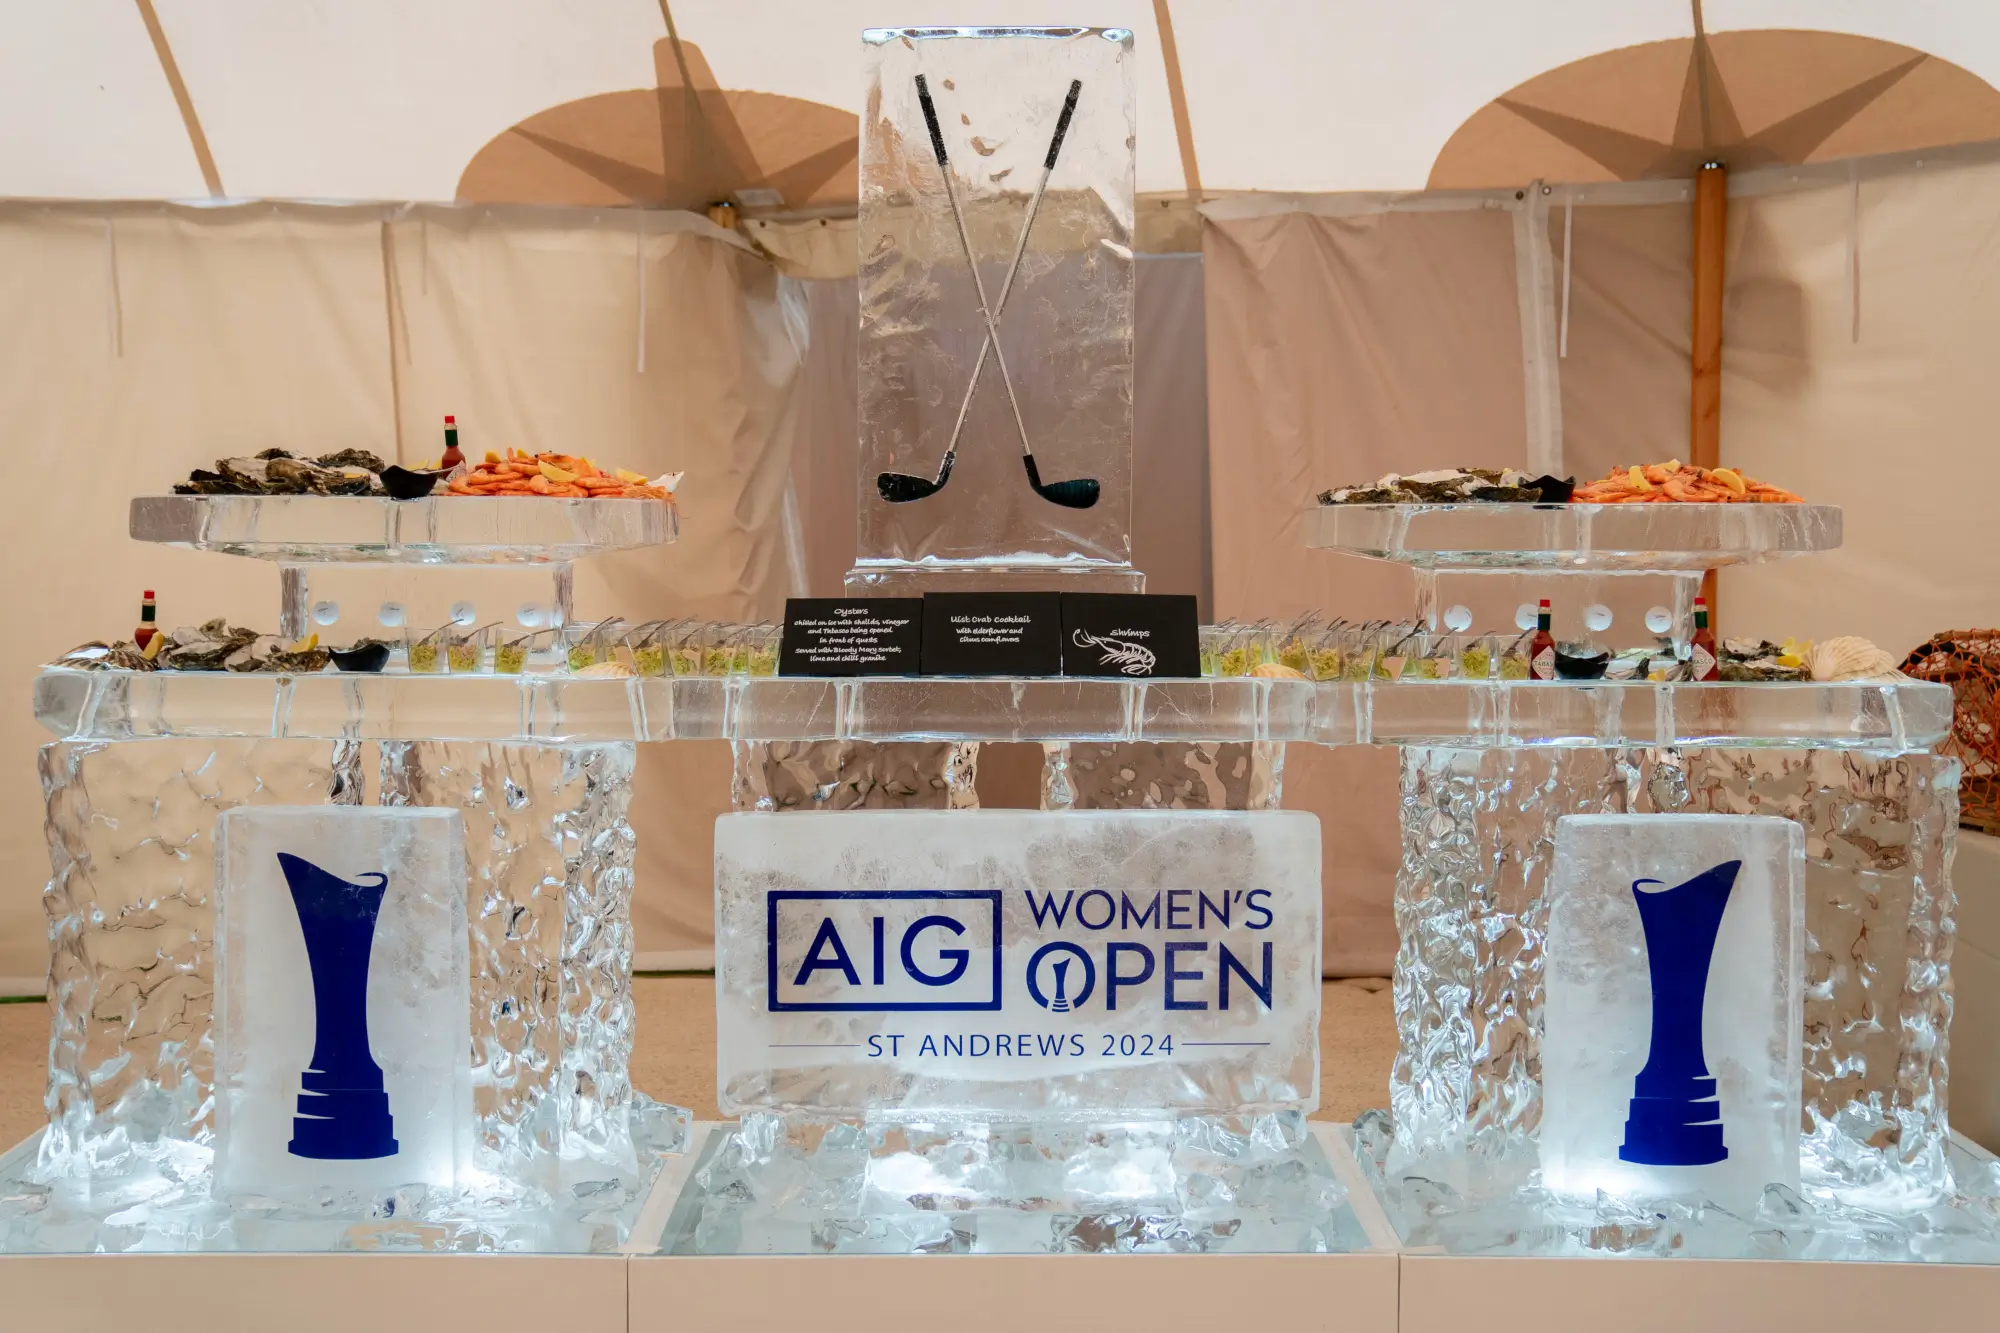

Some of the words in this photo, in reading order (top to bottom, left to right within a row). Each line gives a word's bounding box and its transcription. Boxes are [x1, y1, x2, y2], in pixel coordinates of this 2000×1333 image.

[833, 608, 869, 617] Oysters
[882, 619, 910, 627] vinegar
[950, 615, 971, 623] Uist
[971, 615, 992, 623] Crab
[994, 615, 1031, 623] Cocktail
[849, 627, 869, 635] being
[972, 627, 1009, 636] elderflower
[828, 637, 847, 645] front
[817, 646, 833, 654] with
[833, 647, 858, 655] Bloody
[1024, 889, 1274, 931] WOMEN'S
[793, 915, 970, 987] AIG
[1026, 941, 1273, 1012] OPEN
[867, 1034, 905, 1057] ST
[918, 1034, 1085, 1057] ANDREWS
[1101, 1034, 1174, 1057] 2024
